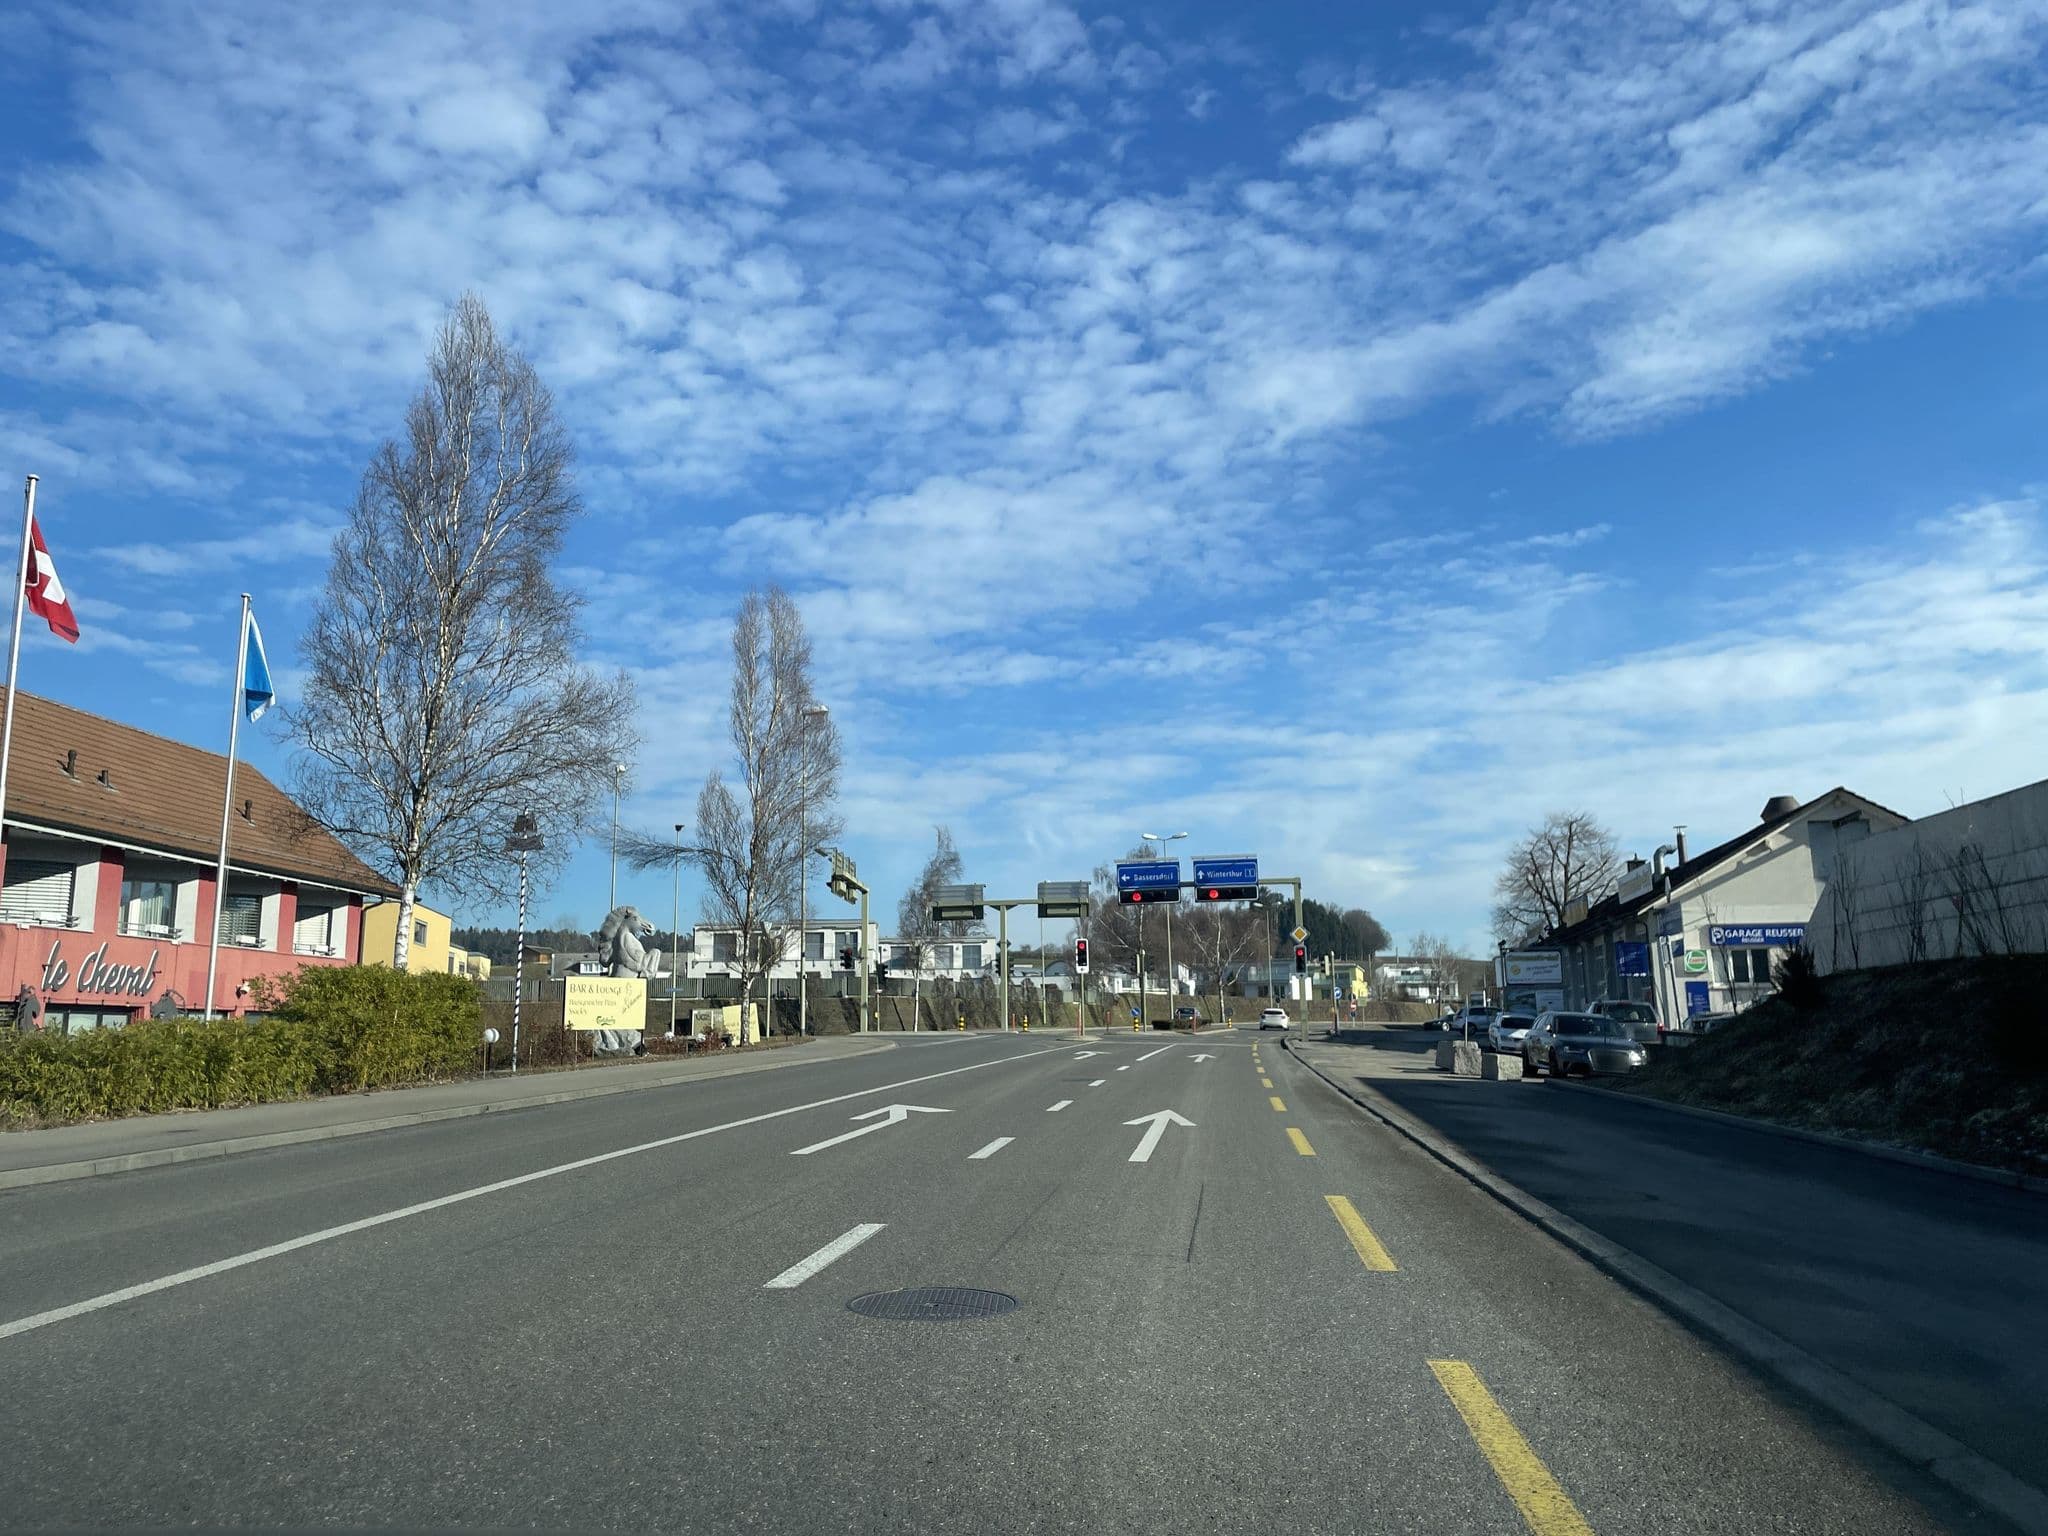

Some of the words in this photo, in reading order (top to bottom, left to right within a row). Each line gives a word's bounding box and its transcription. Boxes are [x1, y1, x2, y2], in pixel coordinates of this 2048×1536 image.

[1133, 871, 1174, 881] Bassersdorf
[1206, 869, 1243, 879] Winterthur
[1725, 929, 1763, 938] GARAGE
[1765, 927, 1804, 938] REUSSER
[77, 941, 159, 997] Cheval
[569, 983, 587, 994] BAR
[588, 983, 594, 994] &
